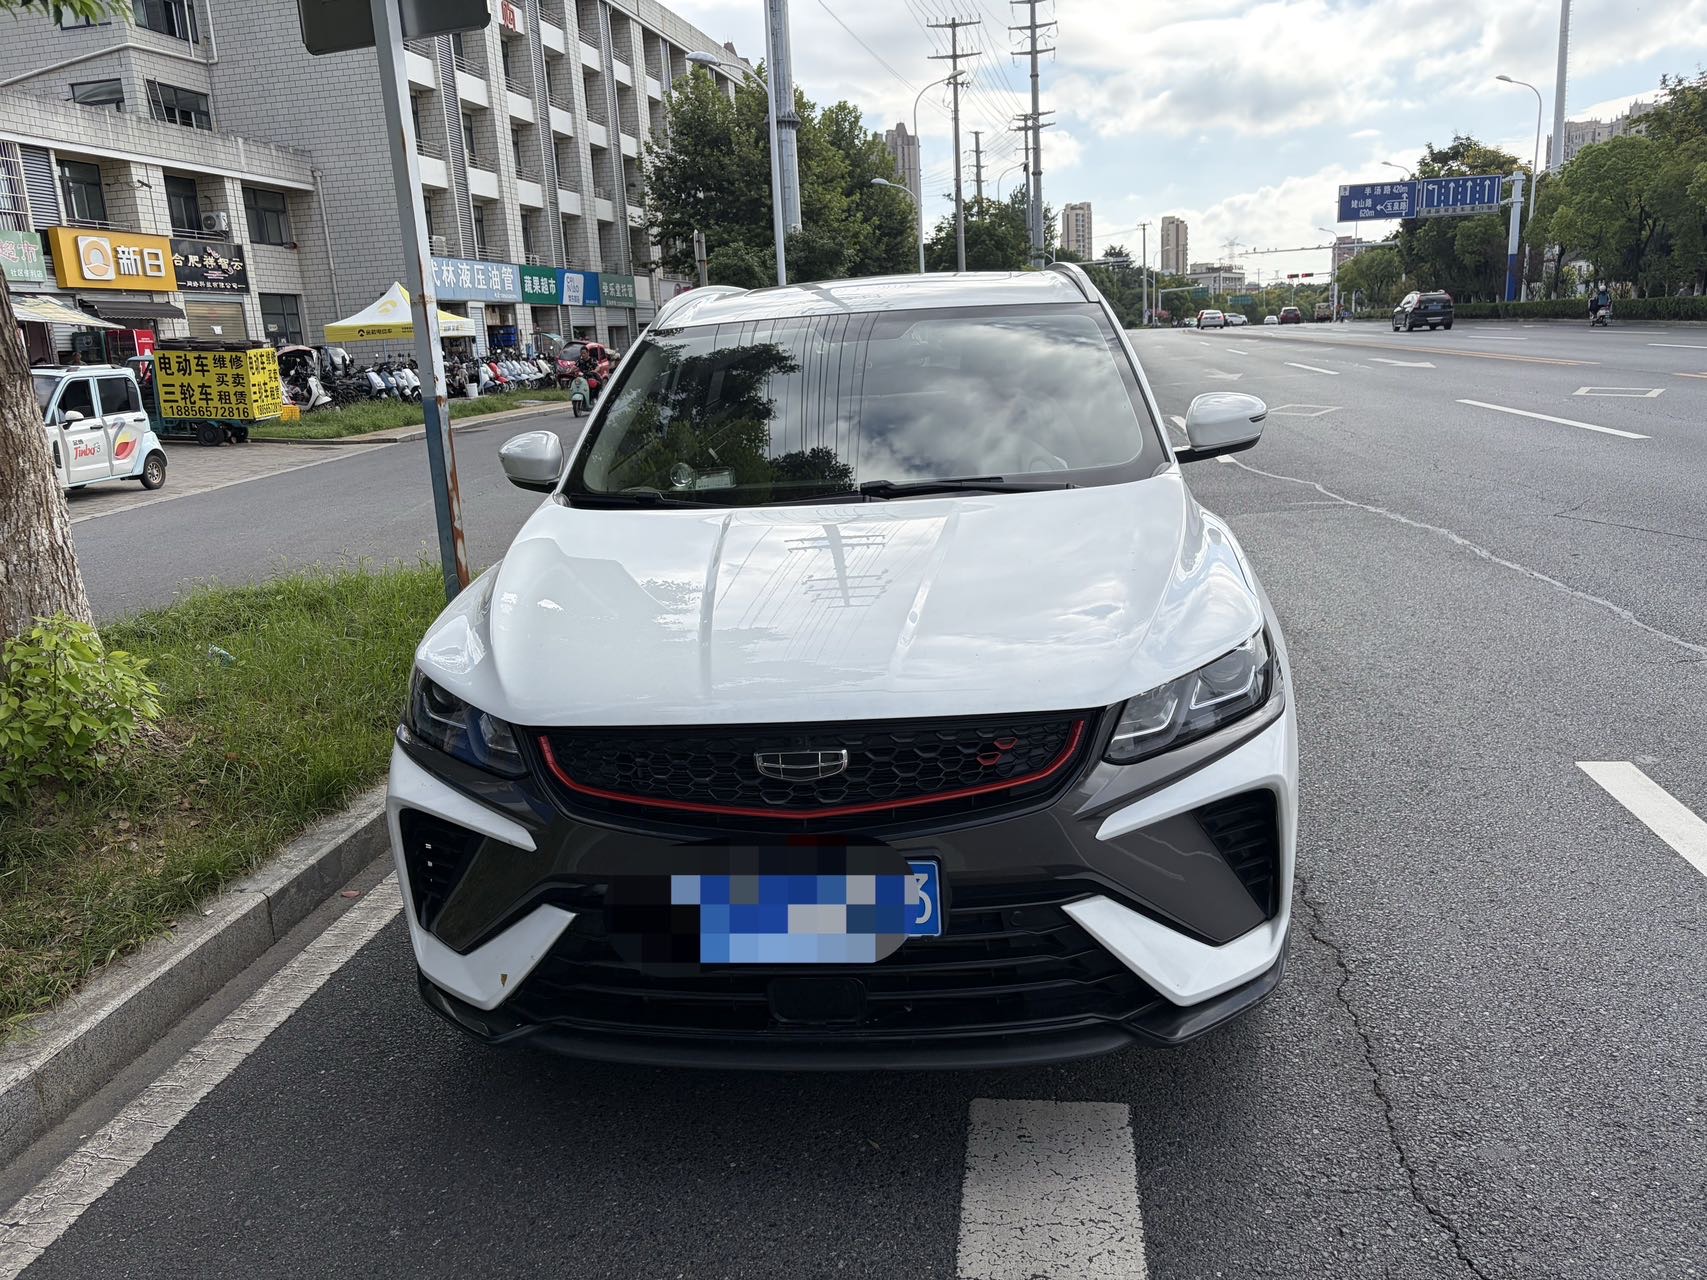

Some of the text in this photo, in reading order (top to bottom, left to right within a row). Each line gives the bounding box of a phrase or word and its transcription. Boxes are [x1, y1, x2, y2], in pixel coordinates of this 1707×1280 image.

[1393, 185, 1408, 194] 420m
[1359, 208, 1375, 217] 620m
[1386, 201, 1407, 211] 玉泉路
[116, 246, 166, 277] 新日
[172, 252, 243, 272] 合肥祥智云
[524, 275, 556, 295] 蔬果超市
[159, 353, 244, 378] 电动车 维修
[248, 351, 277, 375] 电动车 维修
[215, 373, 246, 388] 买卖
[267, 368, 279, 383] 买卖
[162, 382, 248, 406] 三轮车 租赁
[252, 380, 281, 404] 三轮车 租赁
[169, 405, 250, 418] 18856572816
